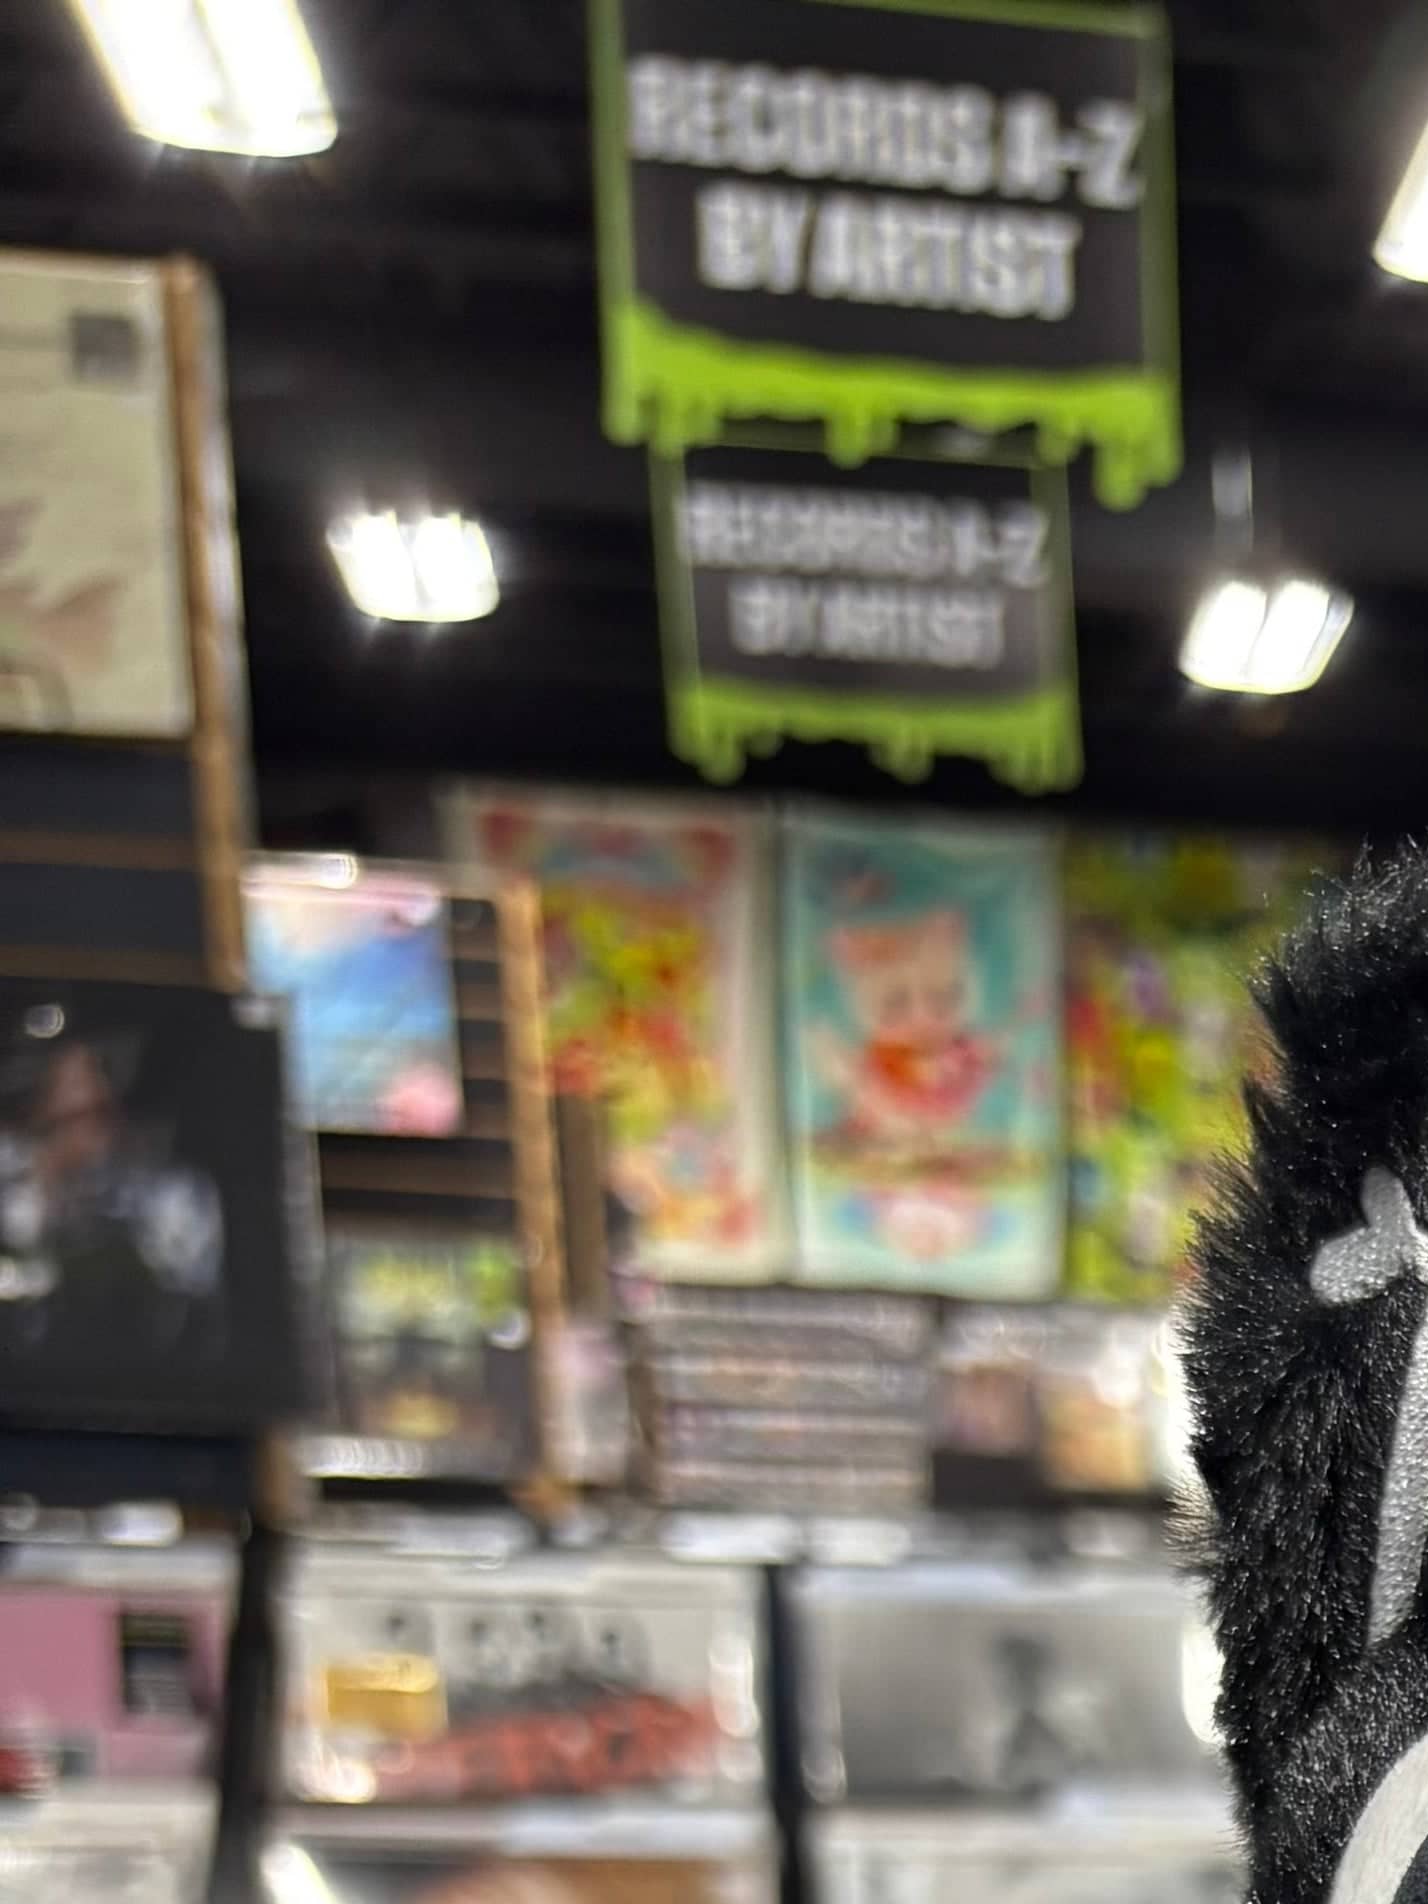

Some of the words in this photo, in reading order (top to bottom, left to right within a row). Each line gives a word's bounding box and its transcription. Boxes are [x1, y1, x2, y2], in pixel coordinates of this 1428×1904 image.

[630, 58, 994, 192] RECORDS
[1004, 93, 1142, 205] A-Z
[701, 183, 803, 291] BY
[809, 196, 1078, 317] ARTIST
